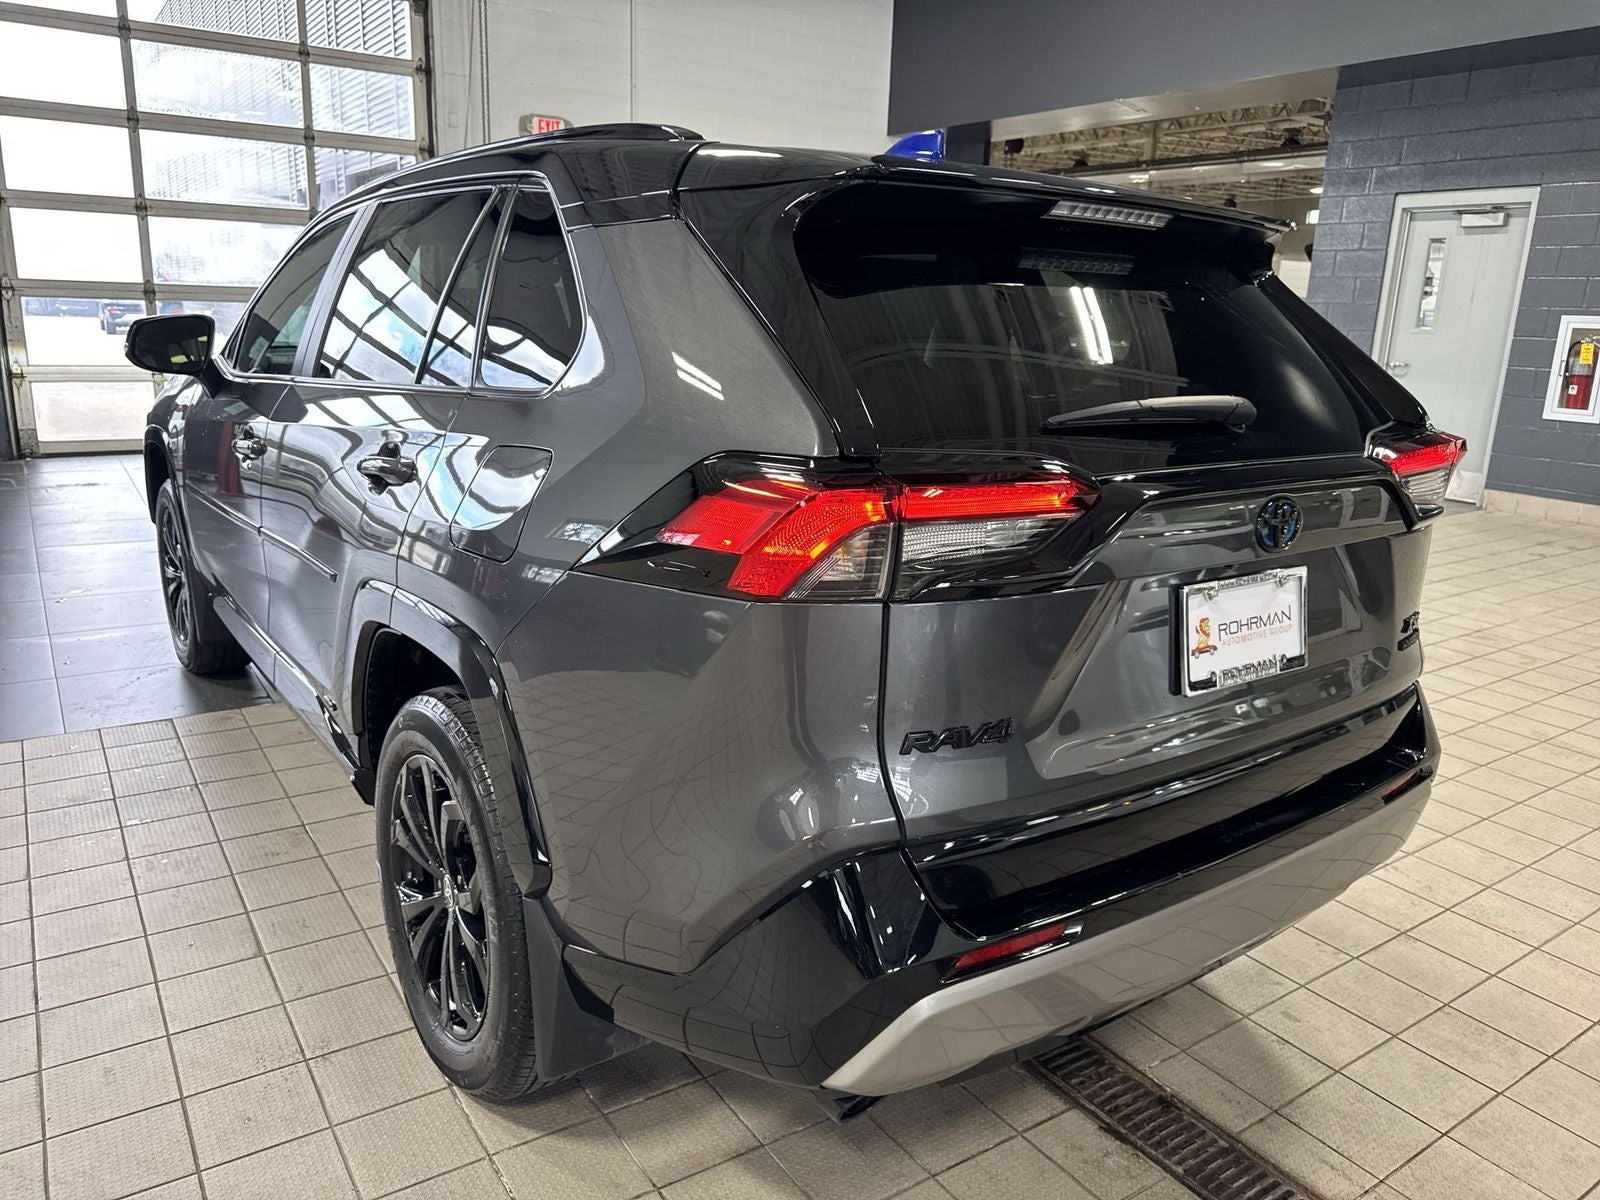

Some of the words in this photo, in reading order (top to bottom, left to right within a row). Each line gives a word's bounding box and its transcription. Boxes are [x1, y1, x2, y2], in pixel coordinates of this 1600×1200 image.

[1218, 604, 1292, 642] ROHRMAN
[1222, 629, 1268, 646] AUTOMOTIVE
[1269, 623, 1293, 636] GROUP
[899, 717, 1014, 756] RAV4
